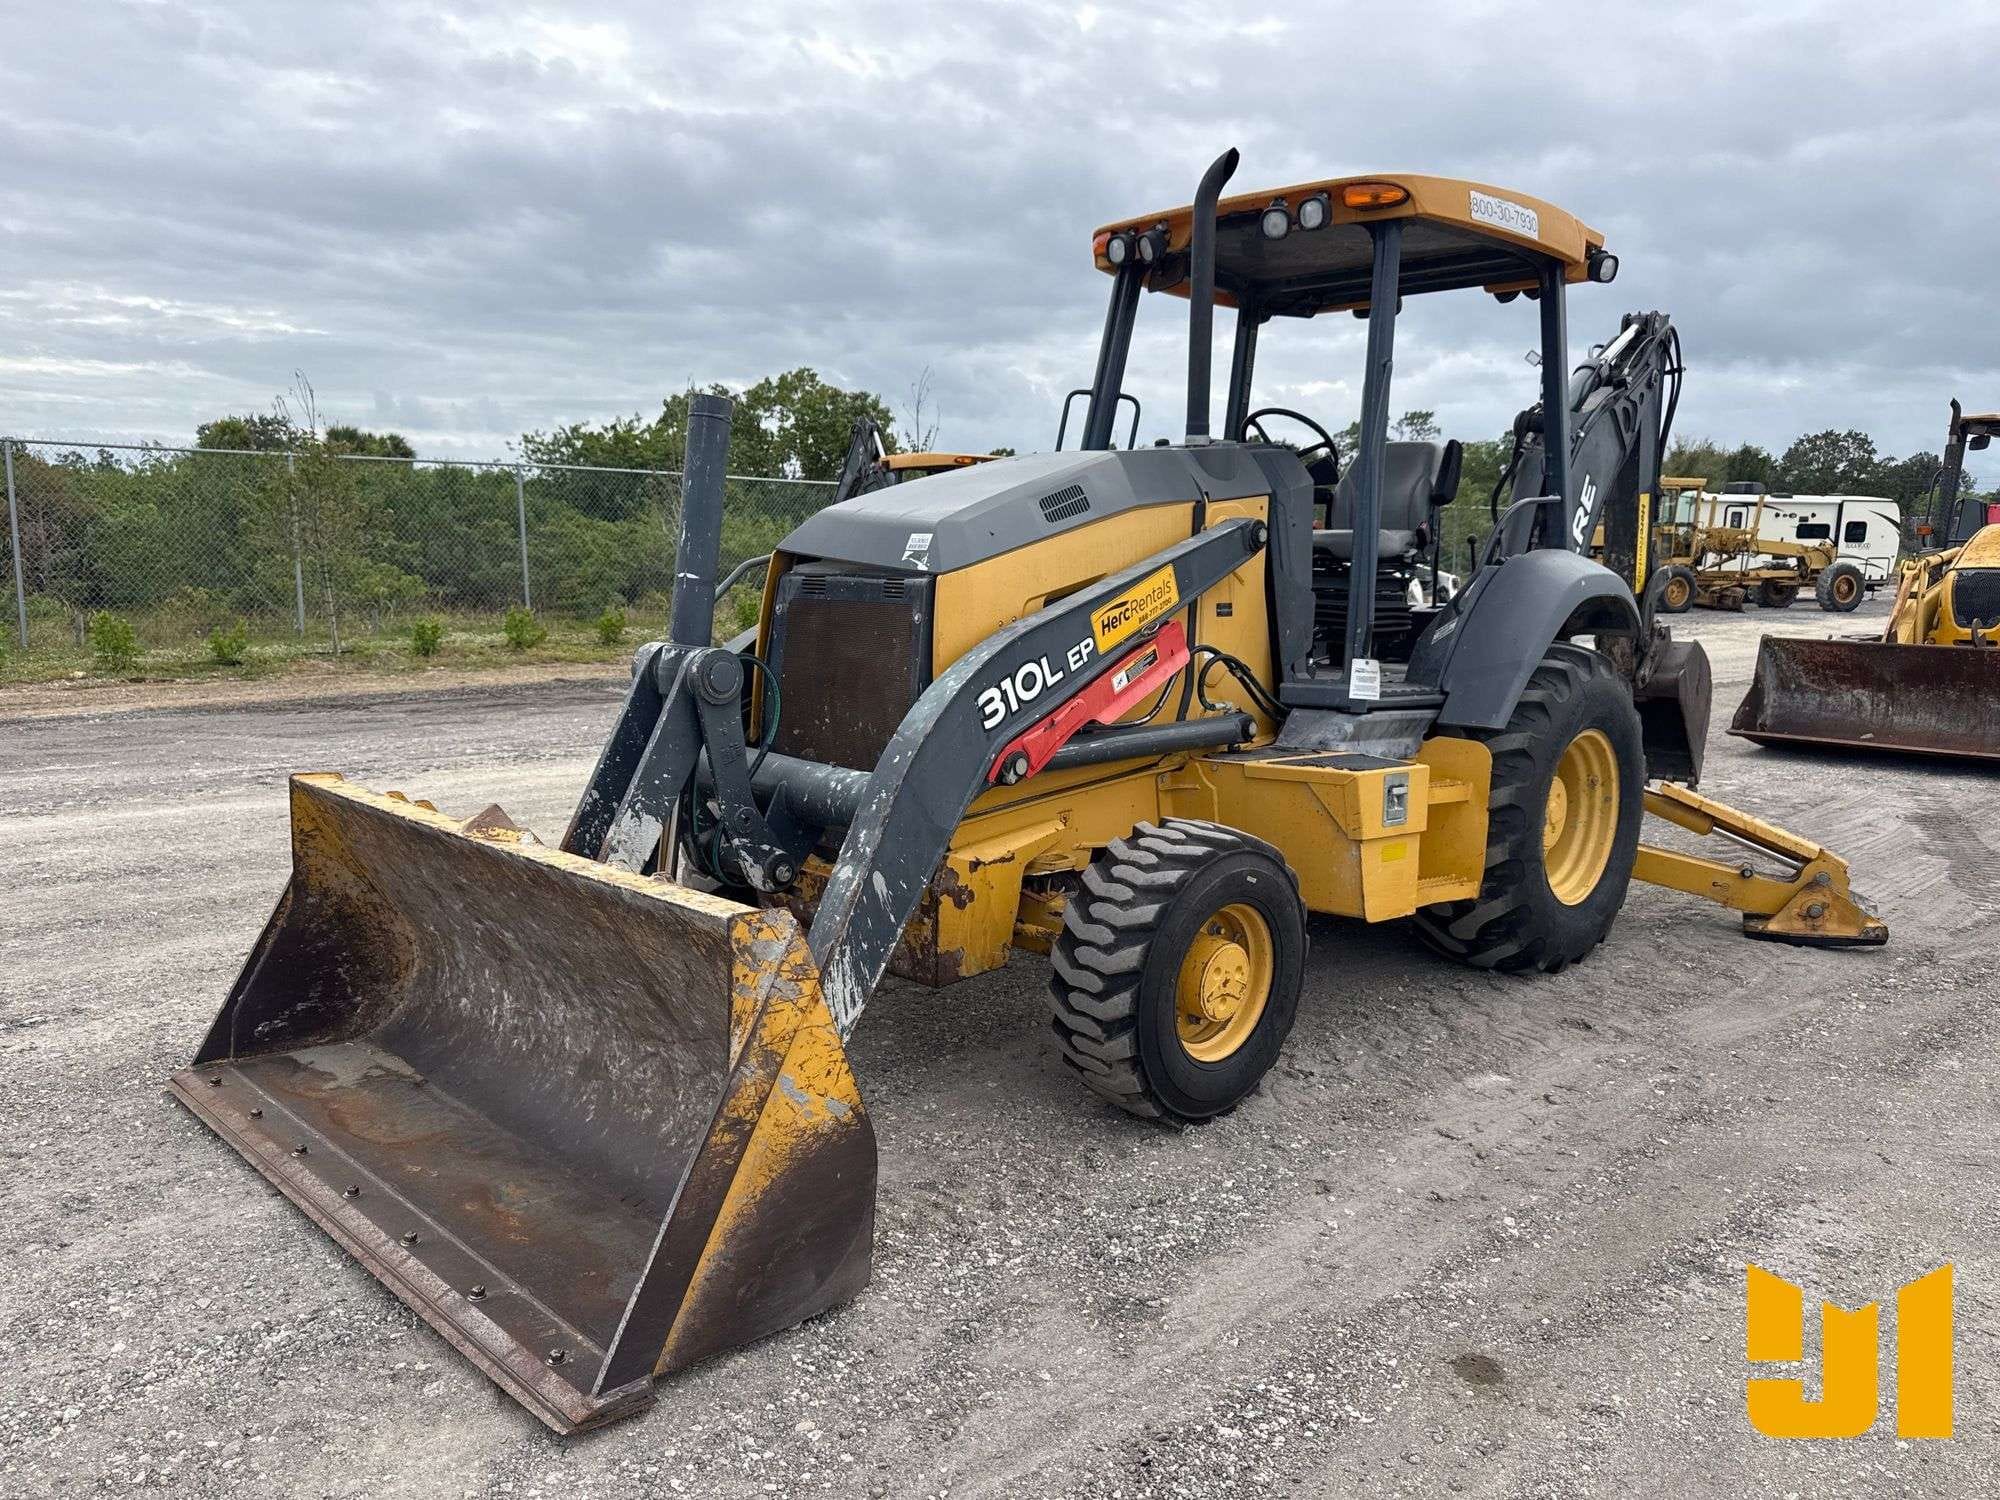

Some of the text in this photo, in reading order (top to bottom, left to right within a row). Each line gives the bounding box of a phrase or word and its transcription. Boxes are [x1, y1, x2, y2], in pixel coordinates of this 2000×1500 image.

[1572, 473, 1597, 554] RE
[1101, 579, 1172, 637] HercRentals
[977, 655, 1065, 731] 310L
[1066, 637, 1095, 673] EP
